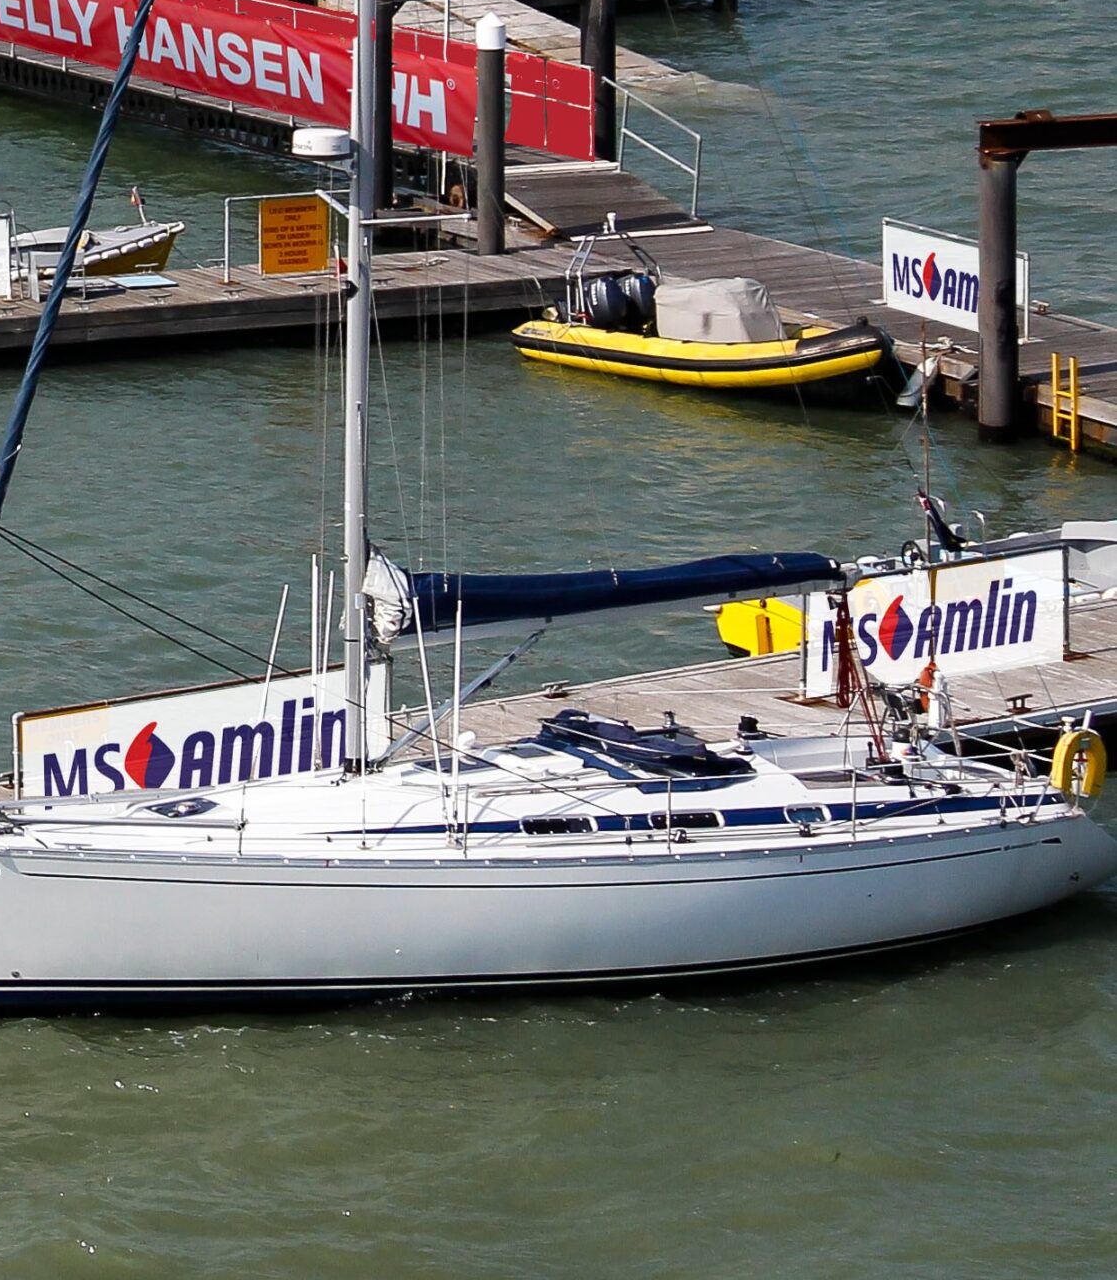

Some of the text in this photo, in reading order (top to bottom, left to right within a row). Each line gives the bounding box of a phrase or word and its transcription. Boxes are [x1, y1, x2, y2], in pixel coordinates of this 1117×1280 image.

[113, 6, 325, 105] HANSEN
[892, 252, 924, 299] MS
[43, 742, 125, 802] MS
